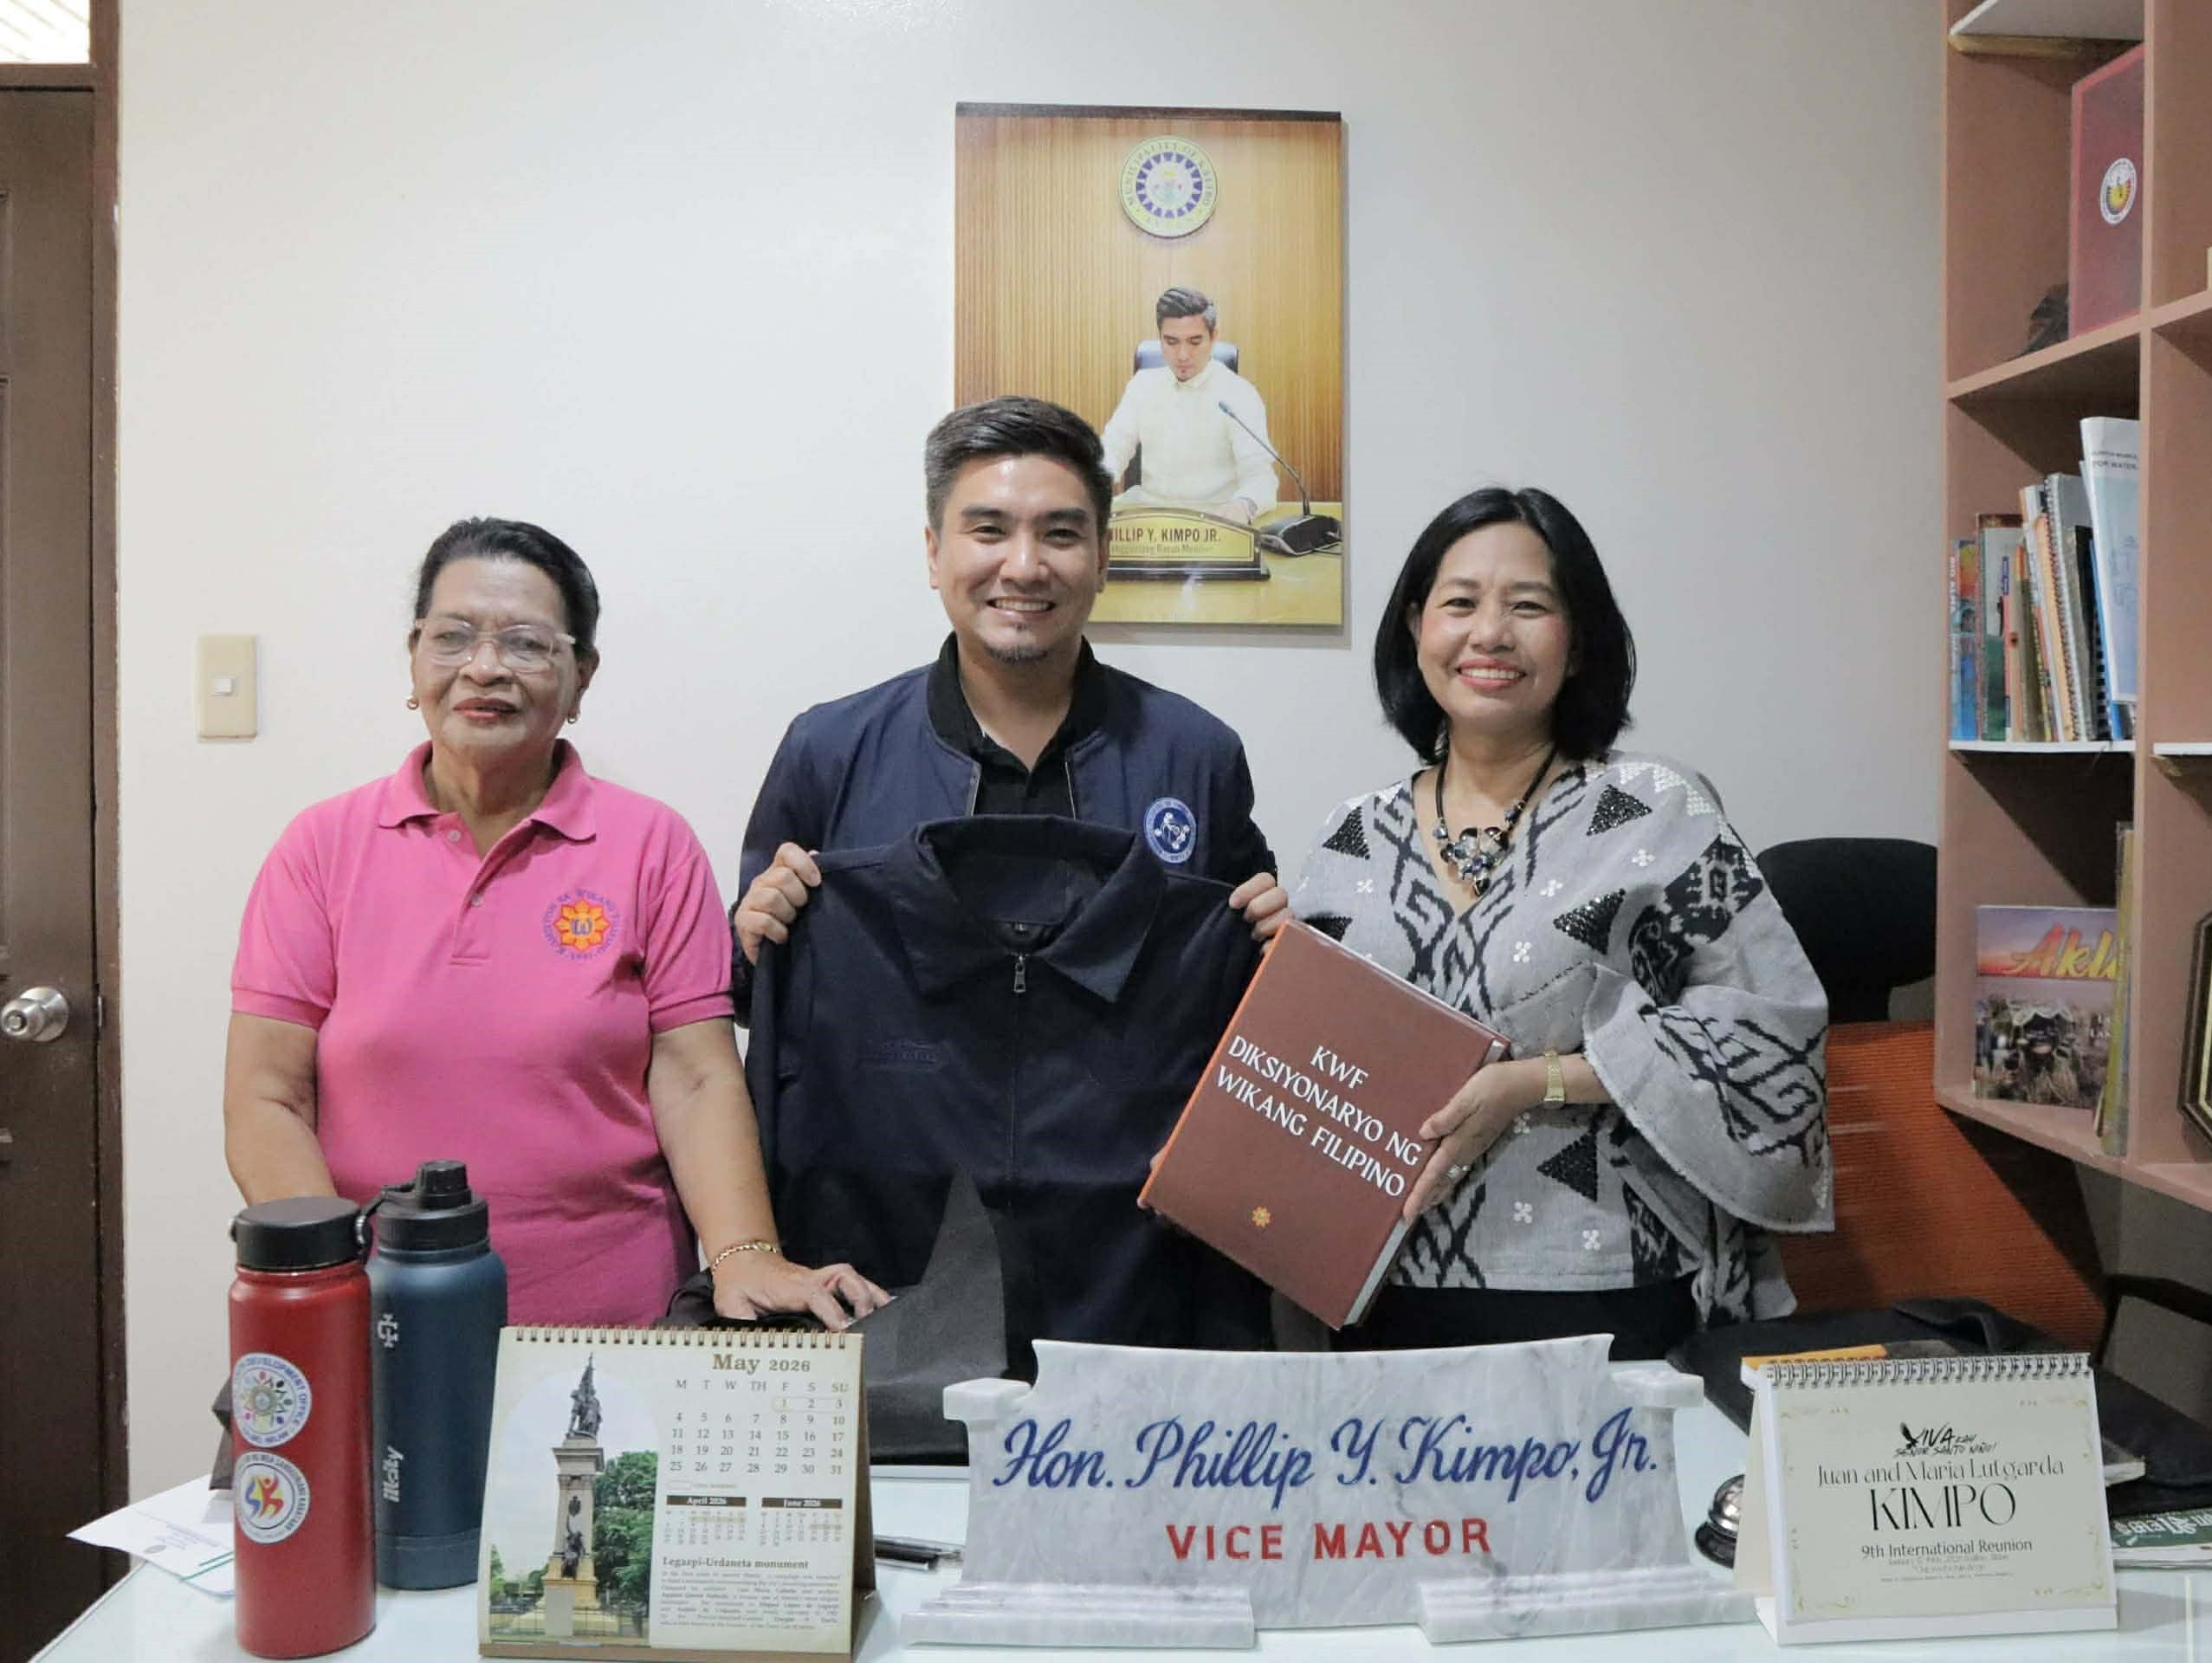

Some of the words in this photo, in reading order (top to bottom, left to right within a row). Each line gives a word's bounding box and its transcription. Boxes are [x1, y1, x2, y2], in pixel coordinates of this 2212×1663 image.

[1161, 528, 1200, 541] KIMPO
[1204, 528, 1220, 541] JR.
[1310, 1045, 1368, 1089] KWF
[1228, 1035, 1384, 1142] DIKSIYONARYO
[1385, 1131, 1422, 1166] NG
[1217, 1065, 1308, 1136] WIKANG
[1310, 1126, 1406, 1196] FILIPINO
[712, 1354, 760, 1375] May
[769, 1360, 811, 1372] 2026
[781, 1398, 786, 1407] 1
[808, 1399, 815, 1408] 2
[837, 1400, 842, 1408] 3
[676, 1413, 682, 1421] 4
[725, 1414, 732, 1422] 6
[753, 1414, 760, 1423] 7
[780, 1414, 786, 1424] 8
[807, 1415, 814, 1424] 9
[833, 1416, 844, 1425] 10
[672, 1428, 682, 1438] 11
[698, 1428, 709, 1439] 12
[722, 1429, 734, 1440] 13
[750, 1431, 761, 1440] 14
[778, 1431, 789, 1440] 15
[805, 1432, 816, 1441] 16
[831, 1433, 844, 1441] 17
[1900, 1421, 1955, 1452] VIVA
[672, 1445, 682, 1455] 18
[696, 1446, 708, 1455] 19
[721, 1446, 733, 1455] 20
[748, 1446, 759, 1456] 21
[776, 1447, 788, 1457] 22
[802, 1448, 815, 1457] 23
[831, 1448, 843, 1458] 24
[993, 1418, 1113, 1488] Hon.
[1125, 1414, 1315, 1511] Phillip
[1330, 1418, 1376, 1485] Y.
[1395, 1414, 1581, 1503] Kimpo,
[1586, 1407, 1657, 1503] Jr.
[669, 1461, 682, 1471] 25
[695, 1462, 707, 1472] 26
[720, 1462, 732, 1472] 27
[747, 1463, 760, 1472] 28
[774, 1464, 787, 1473] 29
[802, 1464, 814, 1474] 30
[831, 1466, 841, 1475] 31
[1818, 1465, 1858, 1487] Juan
[1864, 1462, 1900, 1483] and
[1906, 1460, 1964, 1482] Maria
[1969, 1455, 2065, 1481] Lutgarda
[1870, 1483, 2016, 1530] KIMPO
[1166, 1523, 1283, 1559] VICE
[1314, 1518, 1491, 1559] MAYOR
[1861, 1544, 1885, 1559] 9th
[1889, 1540, 1975, 1557] International
[1979, 1539, 2033, 1553] Reunion
[754, 1560, 809, 1569] monument
